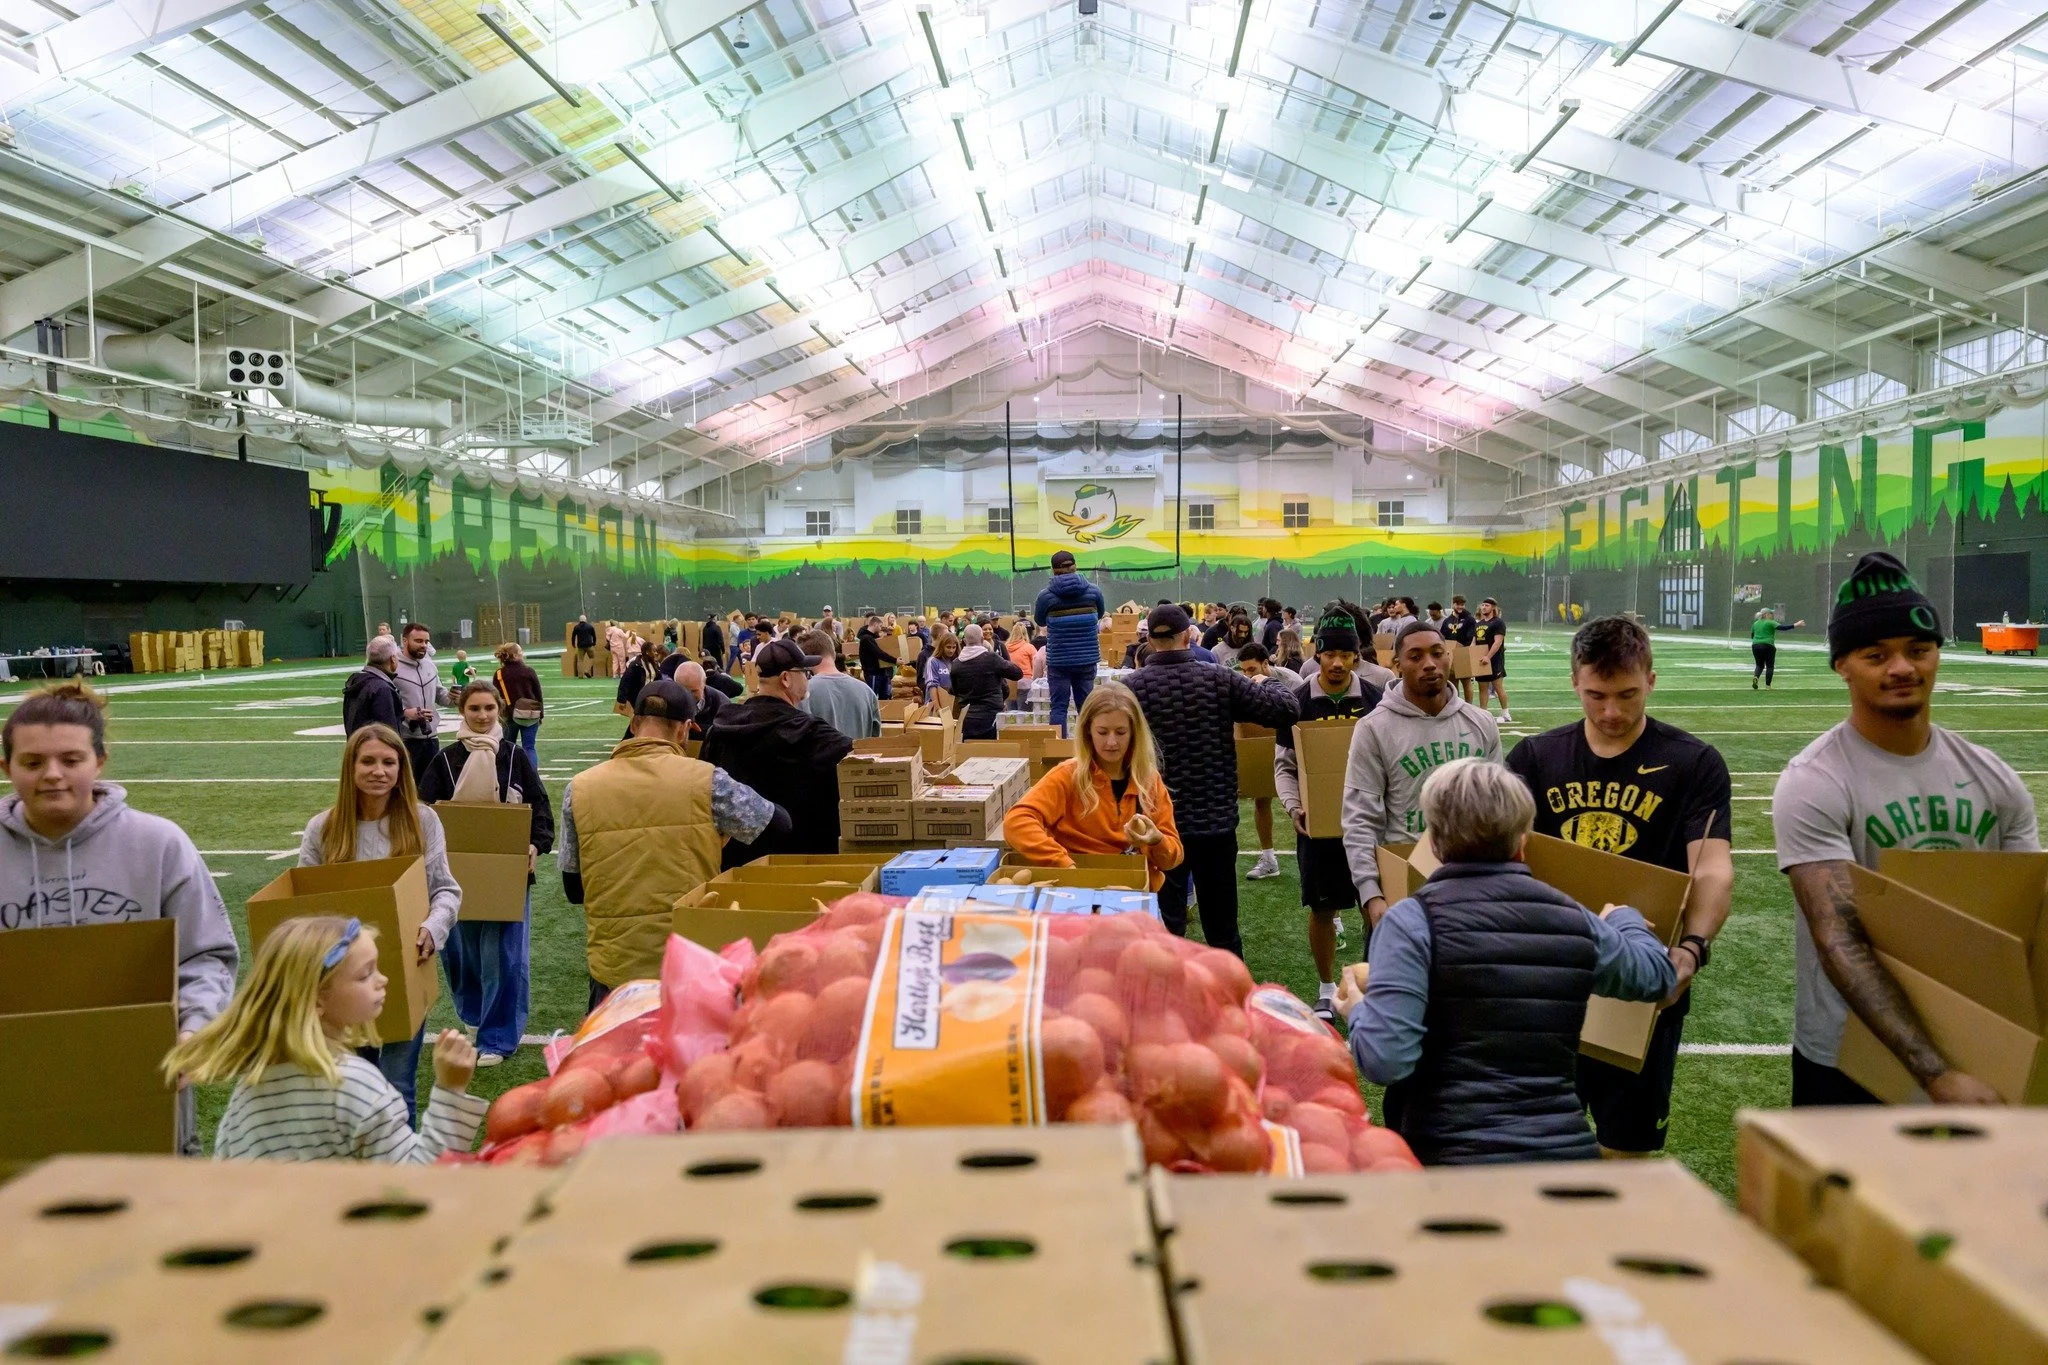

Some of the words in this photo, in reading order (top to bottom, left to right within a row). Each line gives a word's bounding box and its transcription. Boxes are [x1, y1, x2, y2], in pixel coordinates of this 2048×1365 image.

[379, 458, 658, 574] OREGON
[1399, 741, 1486, 779] OREGO
[1546, 781, 1663, 822] OREGON
[1866, 795, 1998, 848] OREGON
